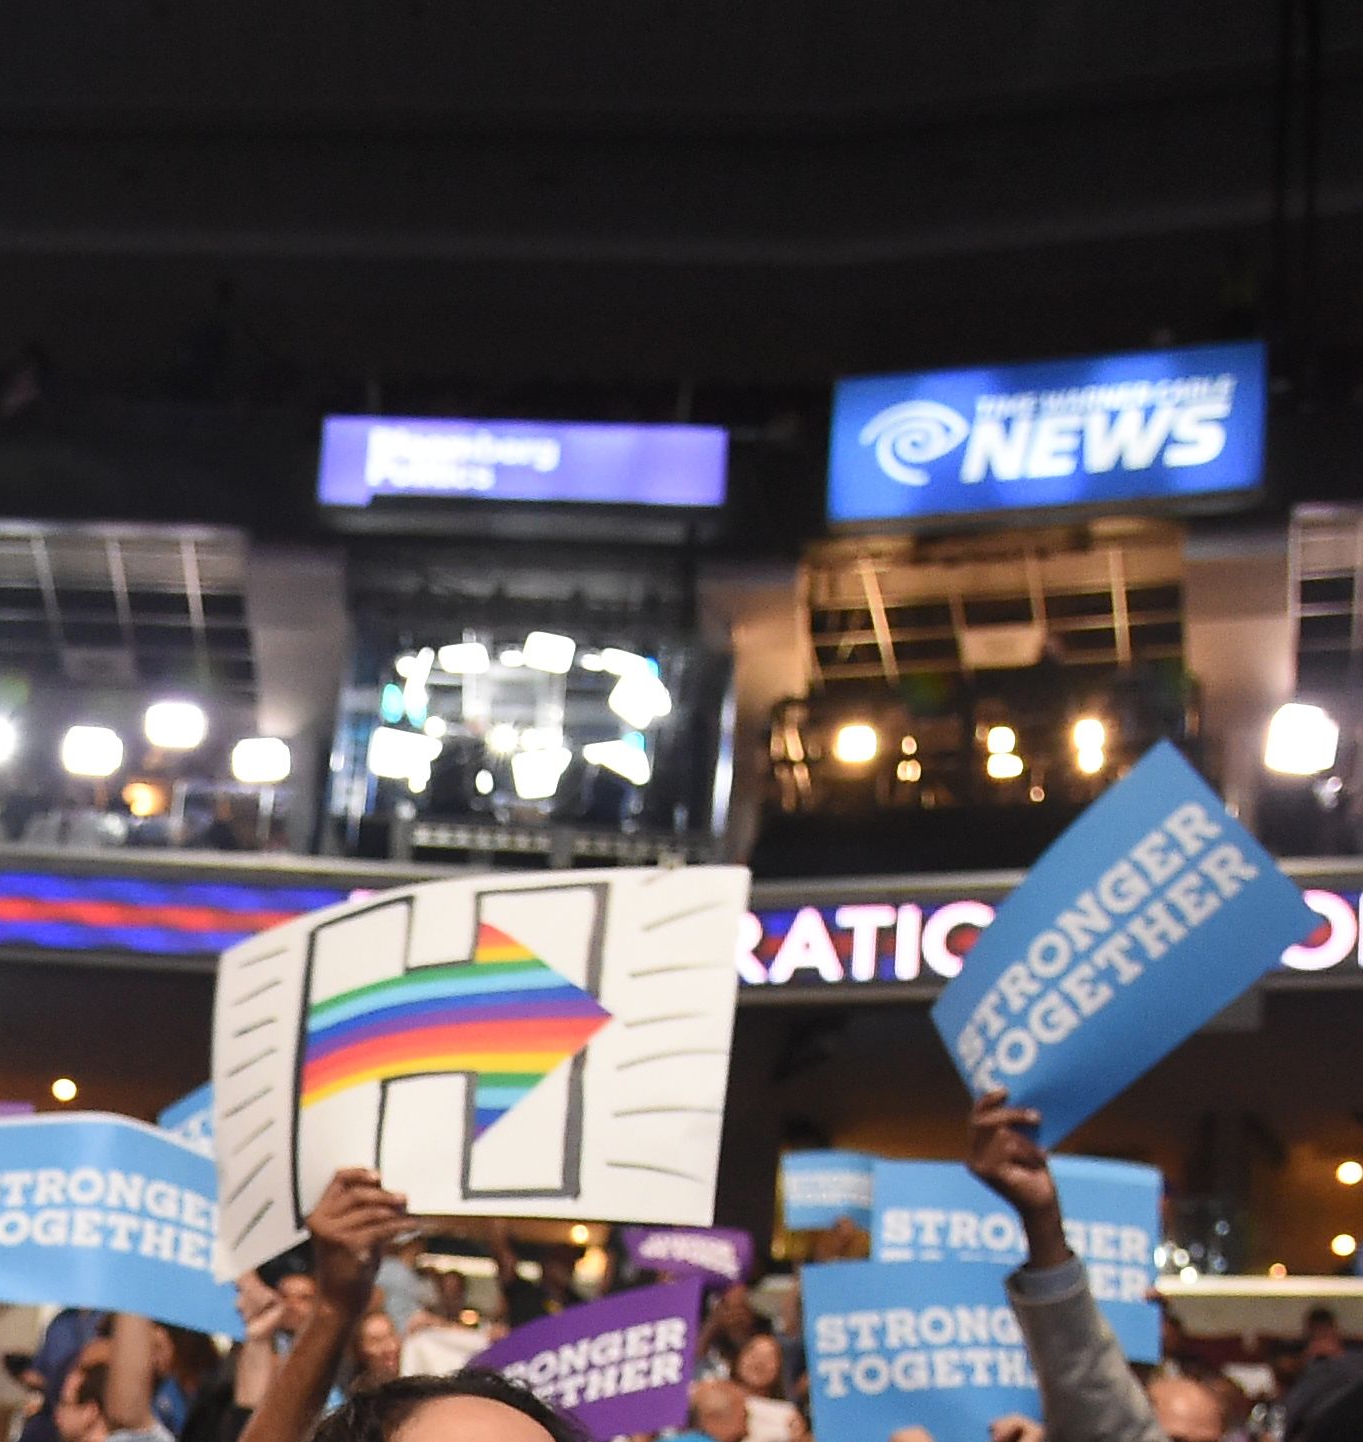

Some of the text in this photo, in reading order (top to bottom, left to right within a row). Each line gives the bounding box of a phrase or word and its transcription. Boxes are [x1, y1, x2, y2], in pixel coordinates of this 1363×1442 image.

[959, 405, 1233, 484] NEWS
[957, 801, 1225, 1070] STRONGER
[973, 843, 1259, 1099] TOGETHER
[815, 1304, 1027, 1354] STRONG
[817, 1346, 1041, 1399] TOGETH
